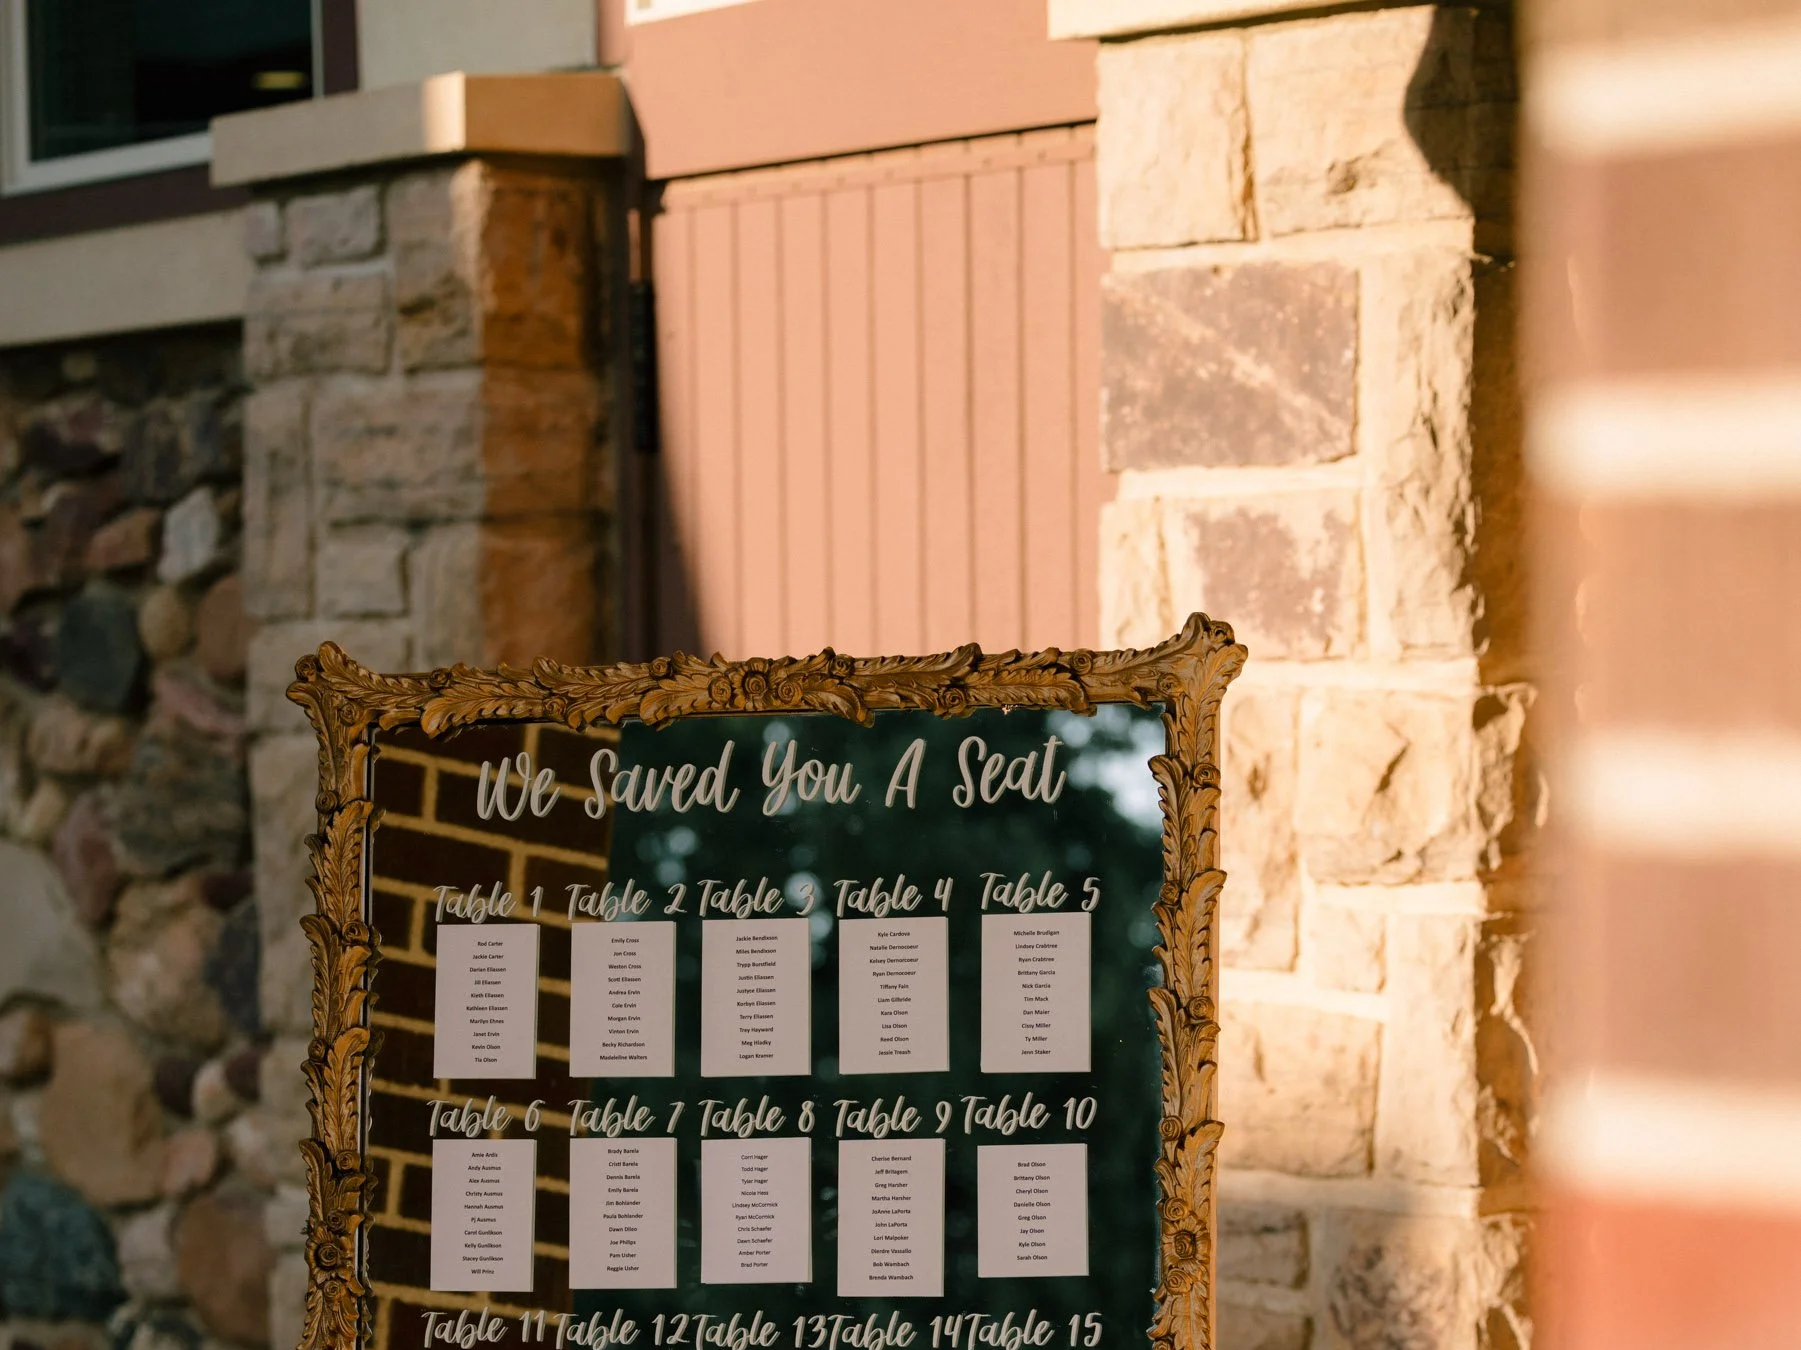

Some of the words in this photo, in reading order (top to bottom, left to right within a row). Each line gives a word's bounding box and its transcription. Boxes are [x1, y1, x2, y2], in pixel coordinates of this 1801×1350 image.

[477, 752, 560, 820] We
[585, 741, 740, 818] Saved
[762, 740, 861, 815] You
[886, 739, 926, 809] A
[953, 736, 1067, 807] Seat
[434, 881, 518, 923] Table
[531, 886, 543, 916] 1
[565, 879, 651, 921] Table
[664, 884, 687, 914] 2
[698, 877, 784, 919] Table
[796, 883, 815, 917] 3
[834, 874, 923, 918] Table
[934, 878, 953, 912] 4
[980, 871, 1069, 914] Table
[1081, 877, 1100, 912] 5
[427, 1096, 513, 1138] Table
[524, 1099, 545, 1132] 6
[568, 1095, 656, 1138] Table
[667, 1101, 685, 1133] 7
[699, 1095, 786, 1138] Table
[798, 1101, 814, 1133] 8
[833, 1096, 921, 1139] Table
[936, 1100, 951, 1132] 9
[960, 1092, 1050, 1135] Table
[1064, 1097, 1097, 1130] 10
[422, 1308, 508, 1349] Table
[520, 1311, 545, 1342] 11
[554, 1309, 640, 1350] Table
[652, 1313, 690, 1345] 12
[793, 1316, 827, 1348] 13
[930, 1315, 964, 1348] 14
[1069, 1312, 1102, 1347] 15
